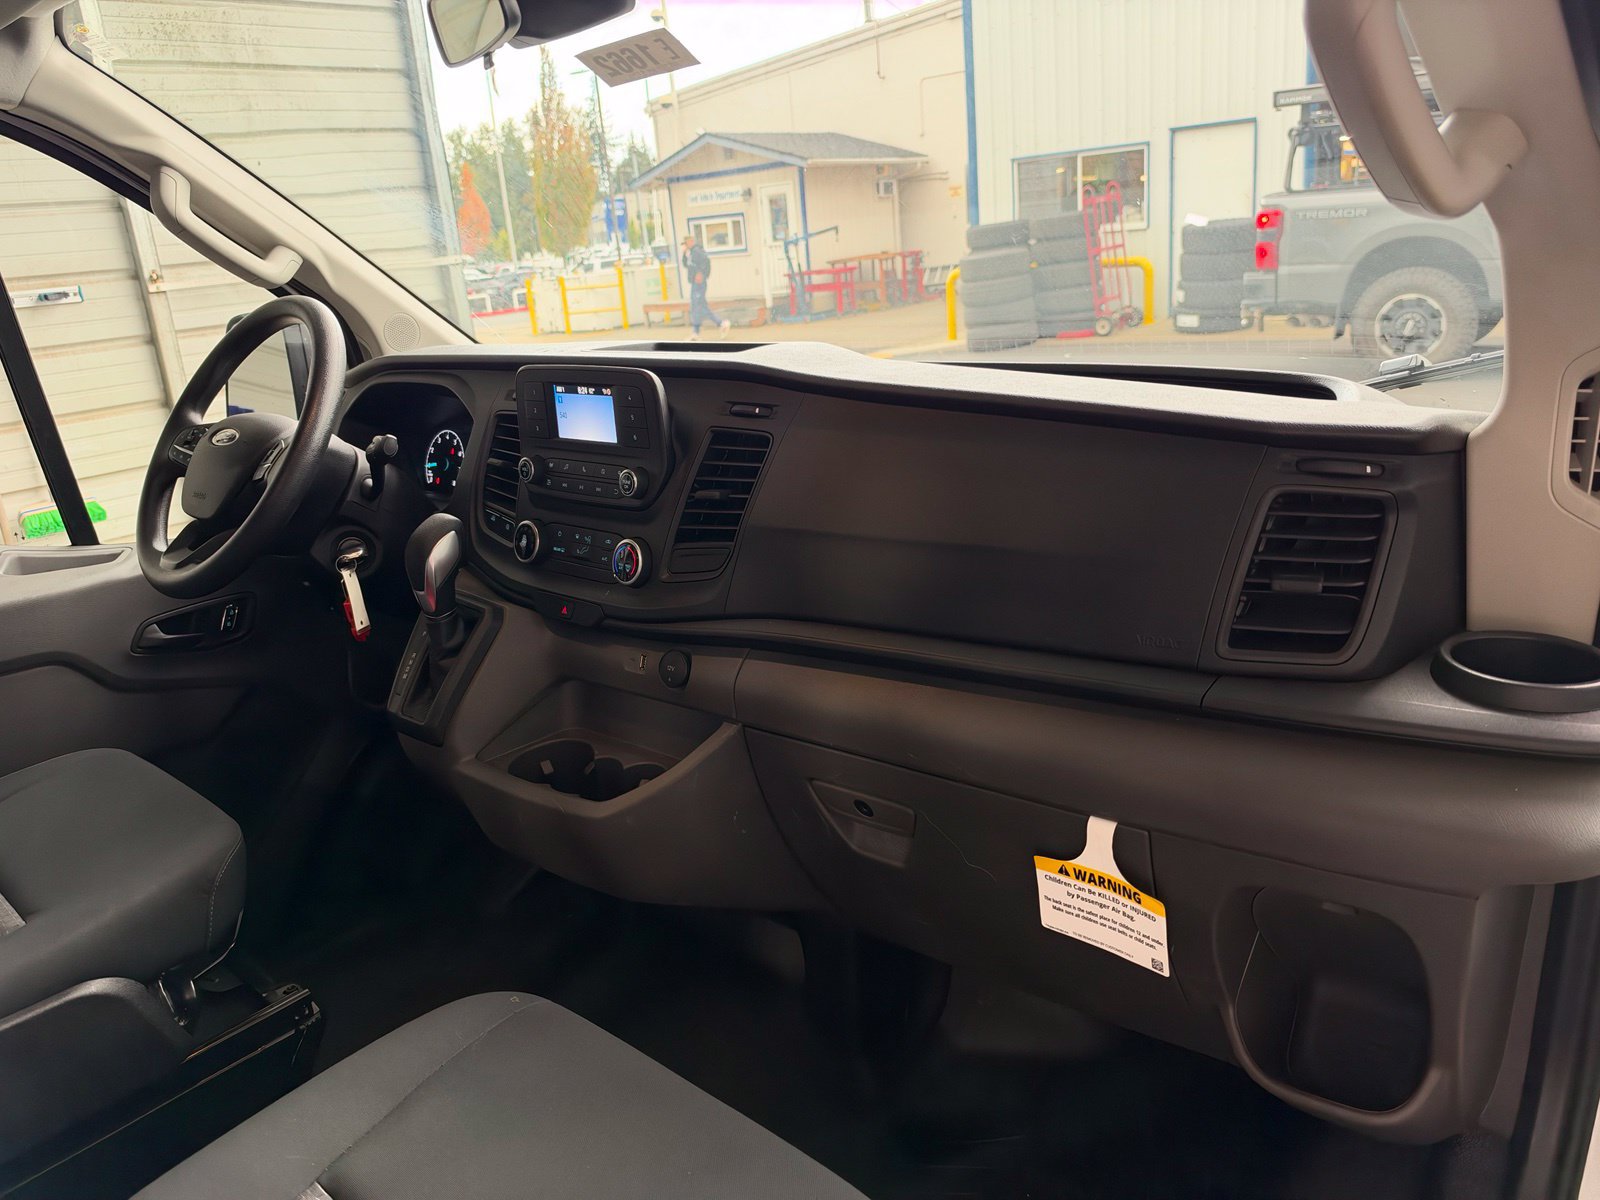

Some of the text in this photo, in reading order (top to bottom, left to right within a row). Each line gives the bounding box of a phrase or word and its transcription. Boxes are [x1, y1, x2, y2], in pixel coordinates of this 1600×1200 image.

[1295, 206, 1369, 222] TREMOR
[1044, 874, 1072, 888] Children
[1073, 883, 1087, 893] Can
[1087, 888, 1097, 896] Be
[1098, 891, 1120, 905] KILLED
[1130, 905, 1157, 922] INJURED
[1066, 890, 1075, 899] by
[1076, 894, 1110, 910] Passenger
[1111, 906, 1121, 914] Air
[1072, 867, 1142, 905] WARNING
[1052, 898, 1063, 906] back
[1085, 909, 1098, 918] safest
[1099, 914, 1111, 923] place
[1118, 922, 1135, 933] children
[1142, 933, 1151, 941] and
[1052, 904, 1064, 912] Make
[1081, 915, 1099, 925] children
[1117, 928, 1128, 937] belts
[1134, 936, 1145, 945] child
